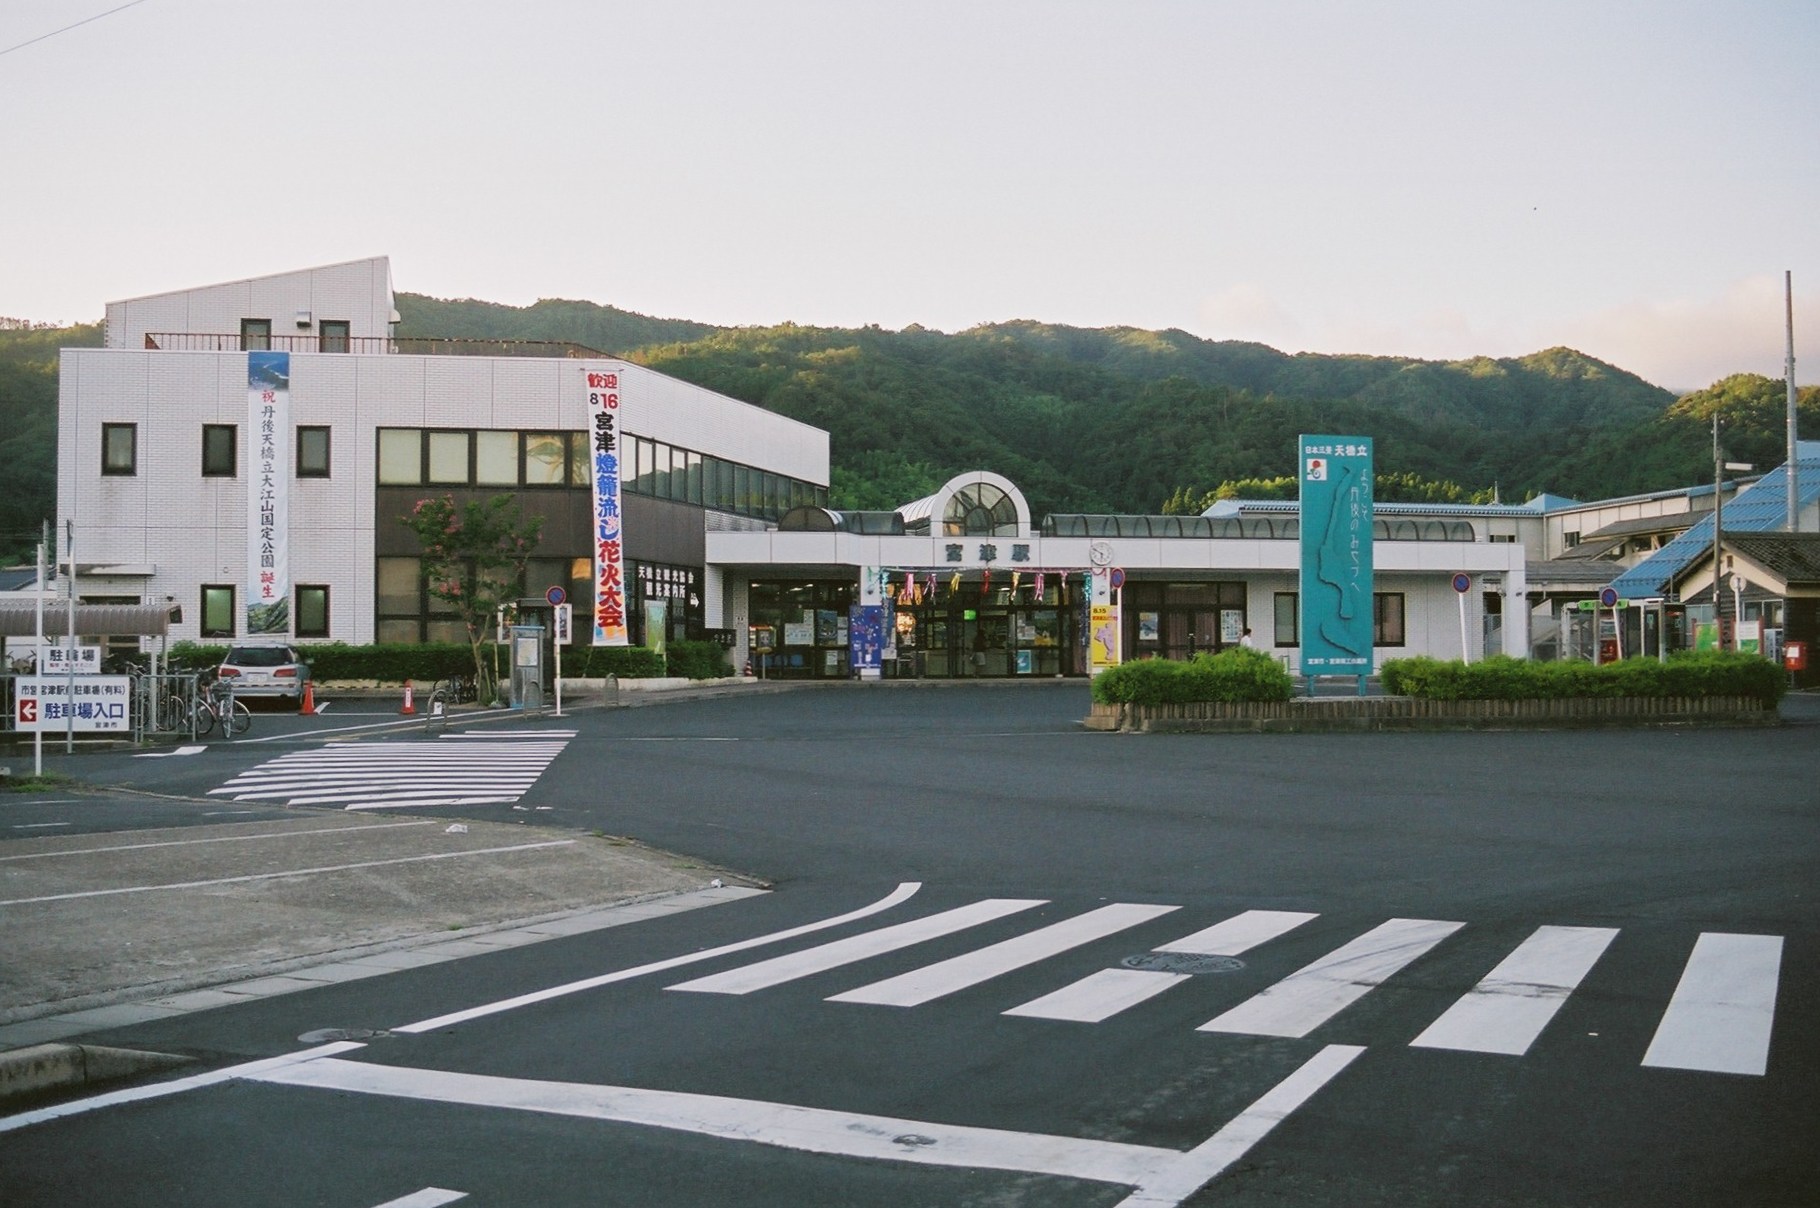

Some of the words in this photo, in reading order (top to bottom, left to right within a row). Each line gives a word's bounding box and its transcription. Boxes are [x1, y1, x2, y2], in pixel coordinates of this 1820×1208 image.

[587, 373, 618, 389] 歓迎
[590, 393, 598, 404] 8
[600, 393, 618, 409] 16
[1334, 445, 1367, 456] 天橋立
[945, 543, 1030, 564] 宮津駅
[45, 703, 124, 719] 駐車場入口
